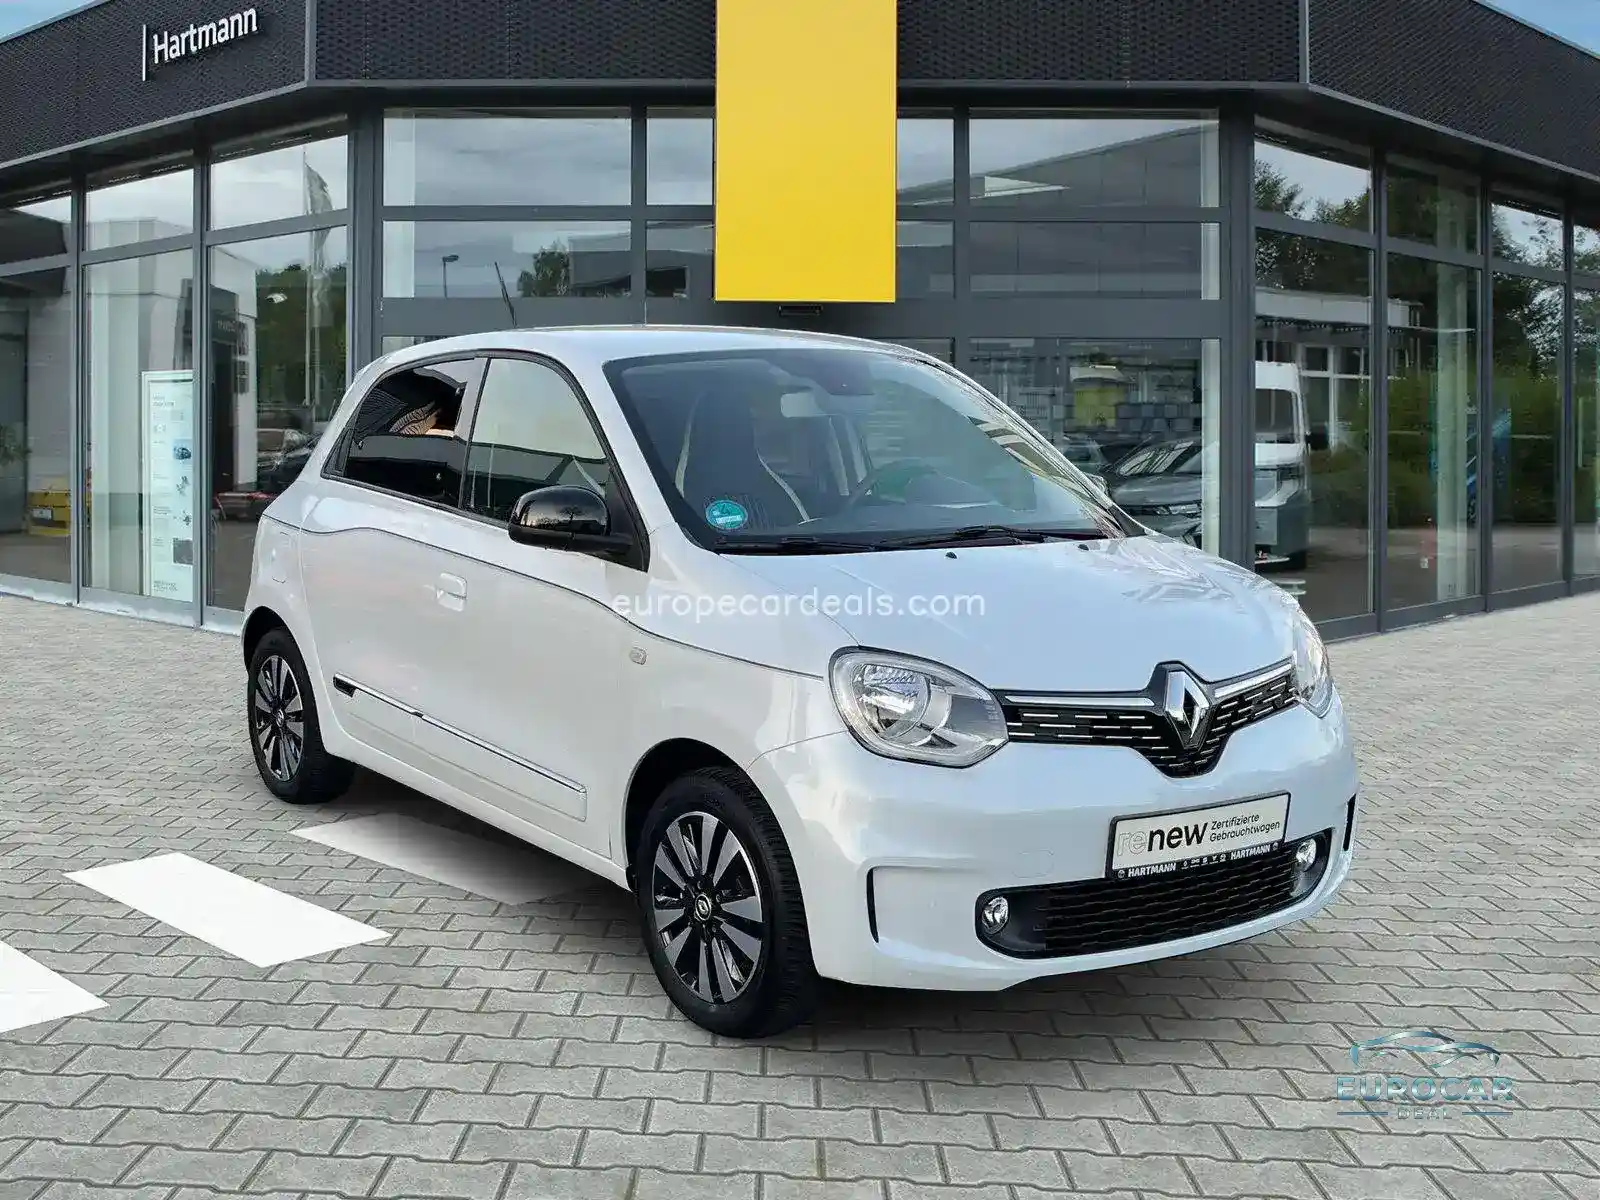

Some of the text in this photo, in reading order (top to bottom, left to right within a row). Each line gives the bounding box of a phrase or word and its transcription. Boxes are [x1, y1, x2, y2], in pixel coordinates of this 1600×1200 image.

[152, 8, 257, 64] Hartmann
[1209, 820, 1281, 842] Gebrauchtwagen
[1211, 813, 1260, 830] Zertifizierte
[1117, 822, 1208, 856] renew
[1127, 862, 1177, 878] HARTMANN
[1230, 844, 1271, 860] HARTMANN
